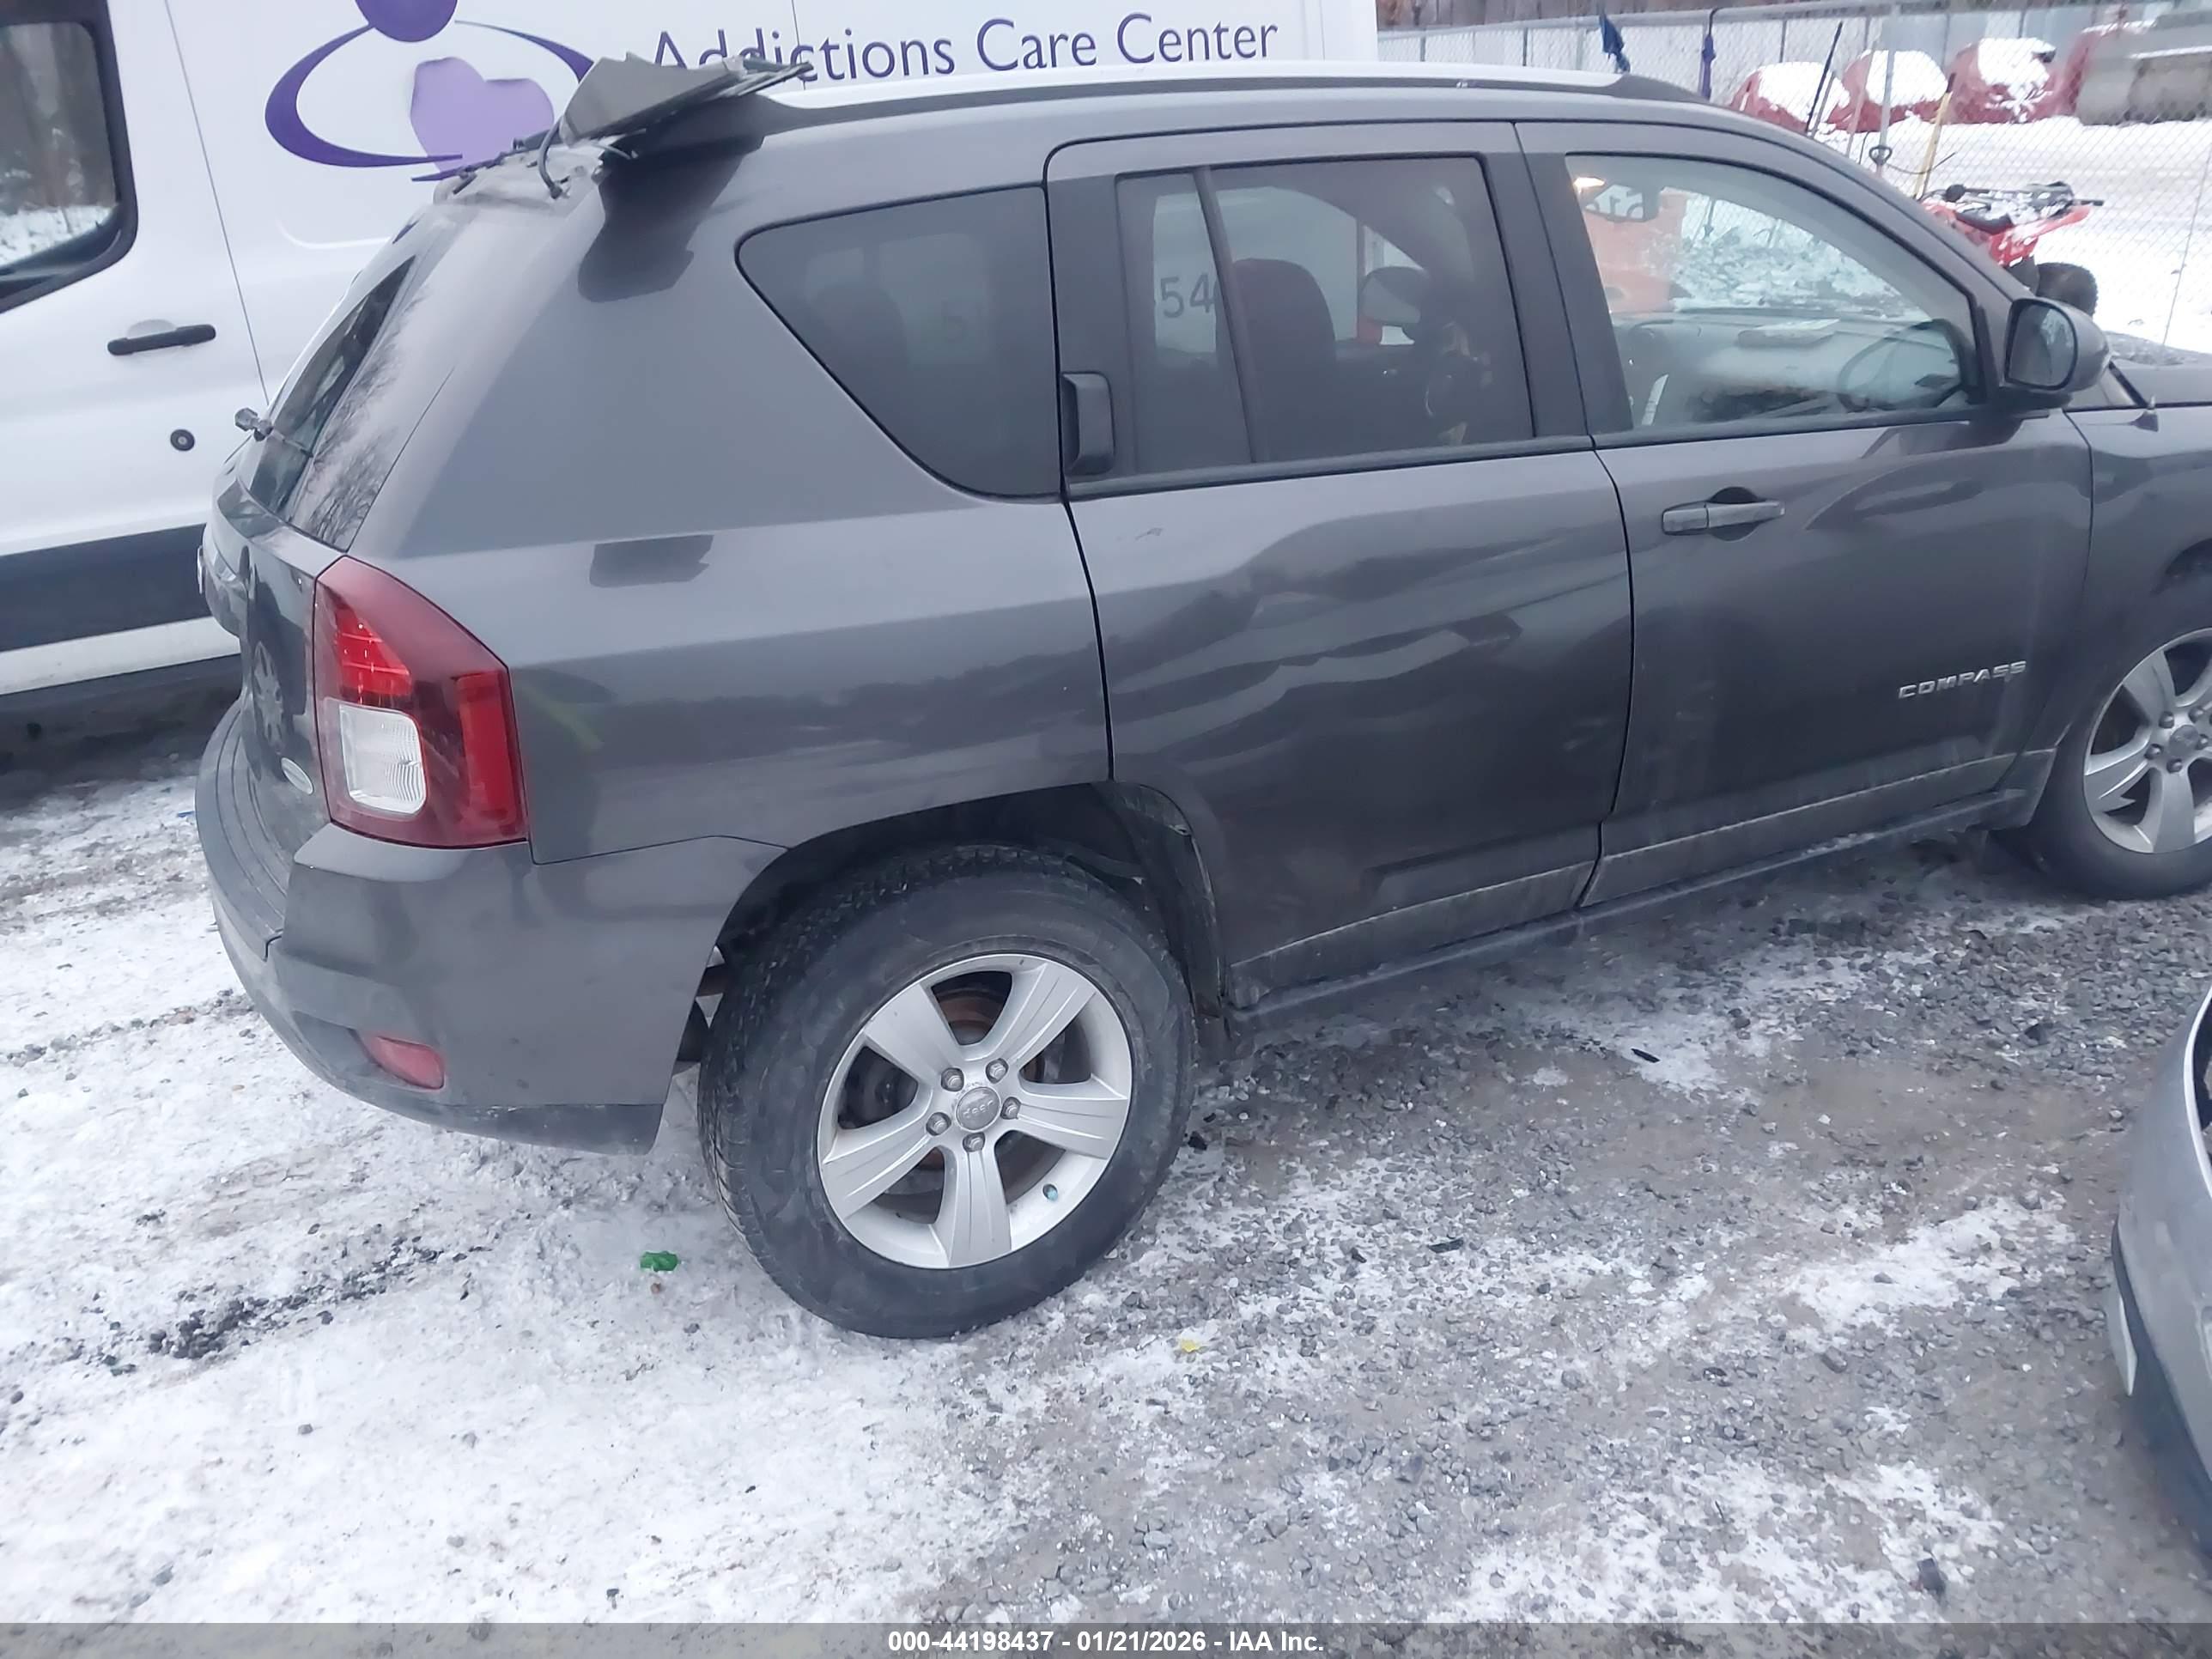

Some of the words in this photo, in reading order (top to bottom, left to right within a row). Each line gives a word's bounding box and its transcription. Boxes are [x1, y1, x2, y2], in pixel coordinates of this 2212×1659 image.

[976, 18, 1097, 71] Care
[1117, 12, 1278, 64] Center
[1160, 272, 1215, 318] 54
[1898, 660, 2027, 699] COMPASS
